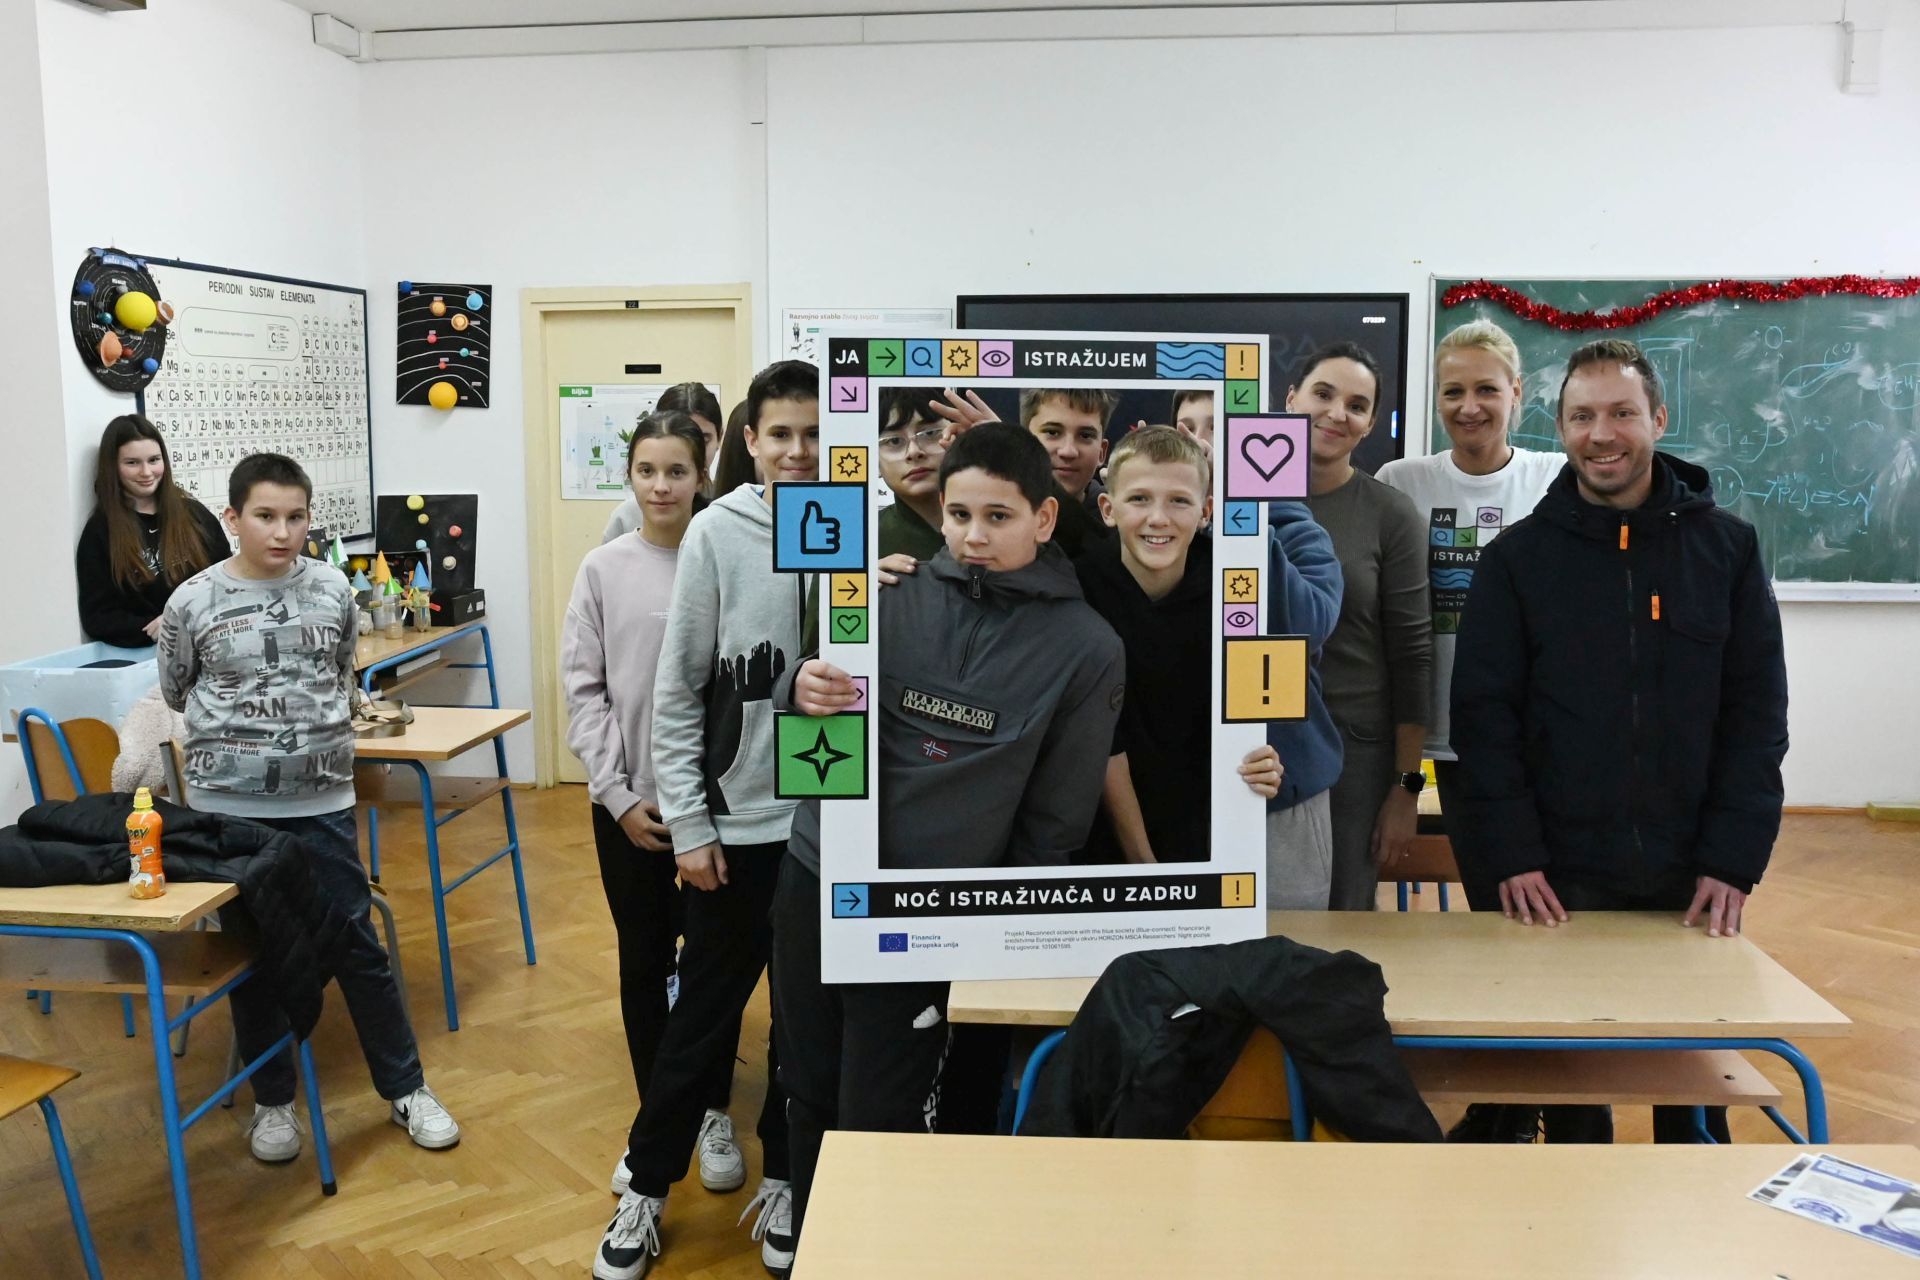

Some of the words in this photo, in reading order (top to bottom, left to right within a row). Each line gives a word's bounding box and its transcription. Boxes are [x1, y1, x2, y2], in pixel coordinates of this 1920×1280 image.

[208, 280, 243, 295] PERIODNI
[249, 285, 274, 299] SUSTAV
[280, 290, 316, 304] ELEMENATA
[836, 350, 859, 364] JA
[1025, 349, 1146, 367] ISTRAŽUJEM
[169, 389, 180, 401] Ca
[184, 390, 194, 401] Sc
[199, 390, 207, 401] Ti
[249, 390, 258, 401] Fe
[172, 420, 180, 432] Sr
[224, 419, 236, 430] Mo
[172, 451, 182, 462] Ba
[187, 450, 197, 462] La
[215, 448, 224, 460] Ta
[190, 480, 199, 491] Ac
[1435, 513, 1452, 522] JA
[233, 625, 254, 635] MORE
[903, 689, 996, 730] NAPAPIJRI
[896, 889, 939, 907] NOĆ
[950, 885, 1094, 907] ISTRAŽIVAČA
[1104, 888, 1115, 902] U
[1125, 886, 1196, 901] ZADRU
